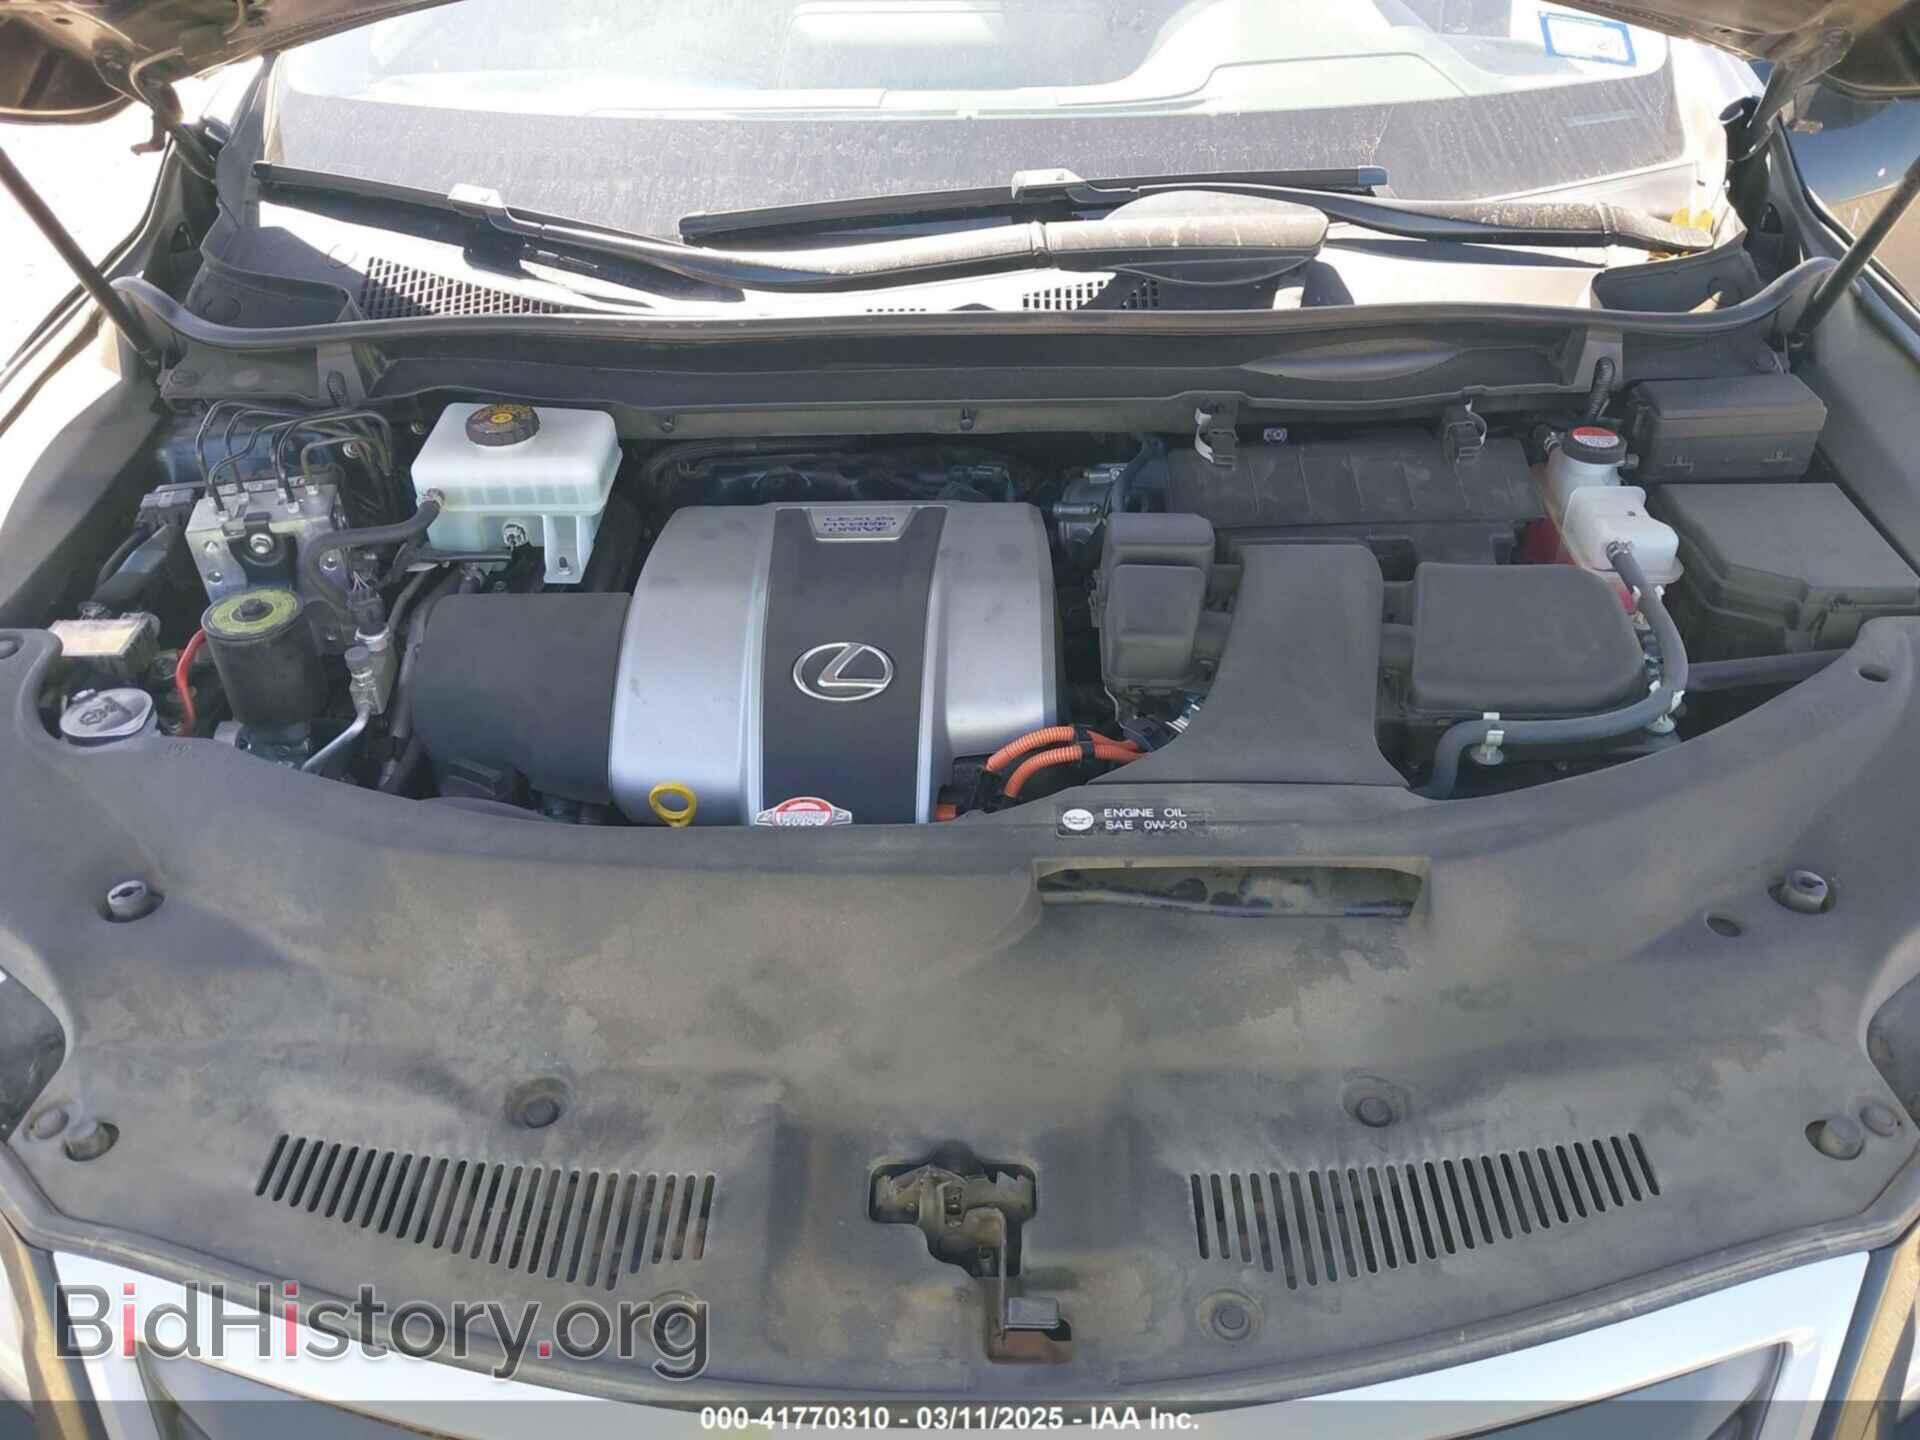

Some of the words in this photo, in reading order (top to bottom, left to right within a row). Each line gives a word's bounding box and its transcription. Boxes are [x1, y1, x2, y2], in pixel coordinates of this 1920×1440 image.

[1103, 807, 1155, 818] ENGINE
[1163, 807, 1188, 818] OIL
[1104, 819, 1134, 831] SAE
[1143, 819, 1188, 831] 0W-20
